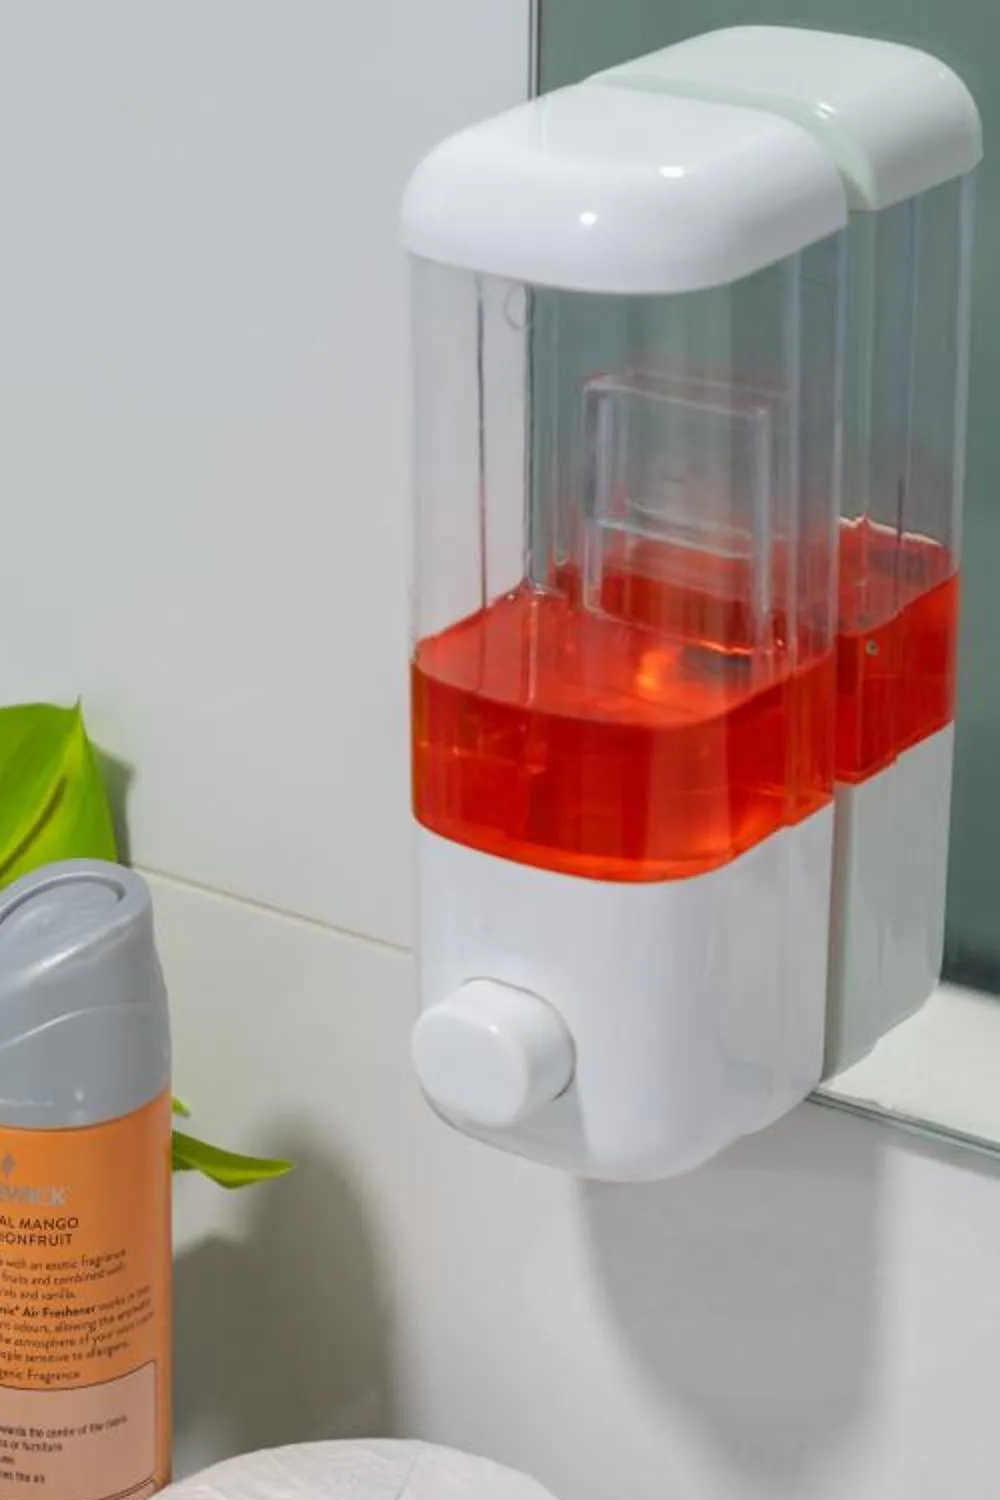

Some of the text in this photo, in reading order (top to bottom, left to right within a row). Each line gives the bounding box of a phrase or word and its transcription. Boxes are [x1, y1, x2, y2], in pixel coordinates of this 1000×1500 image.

[18, 1216, 80, 1231] MANGO
[81, 1247, 127, 1271] fragrance
[30, 1273, 51, 1286] and
[53, 1268, 105, 1286] combined
[19, 1288, 39, 1301] and
[22, 1306, 39, 1318] Air
[43, 1304, 96, 1318] Freshener
[14, 1337, 76, 1351] atmosphere
[27, 1368, 81, 1385] Fragrance
